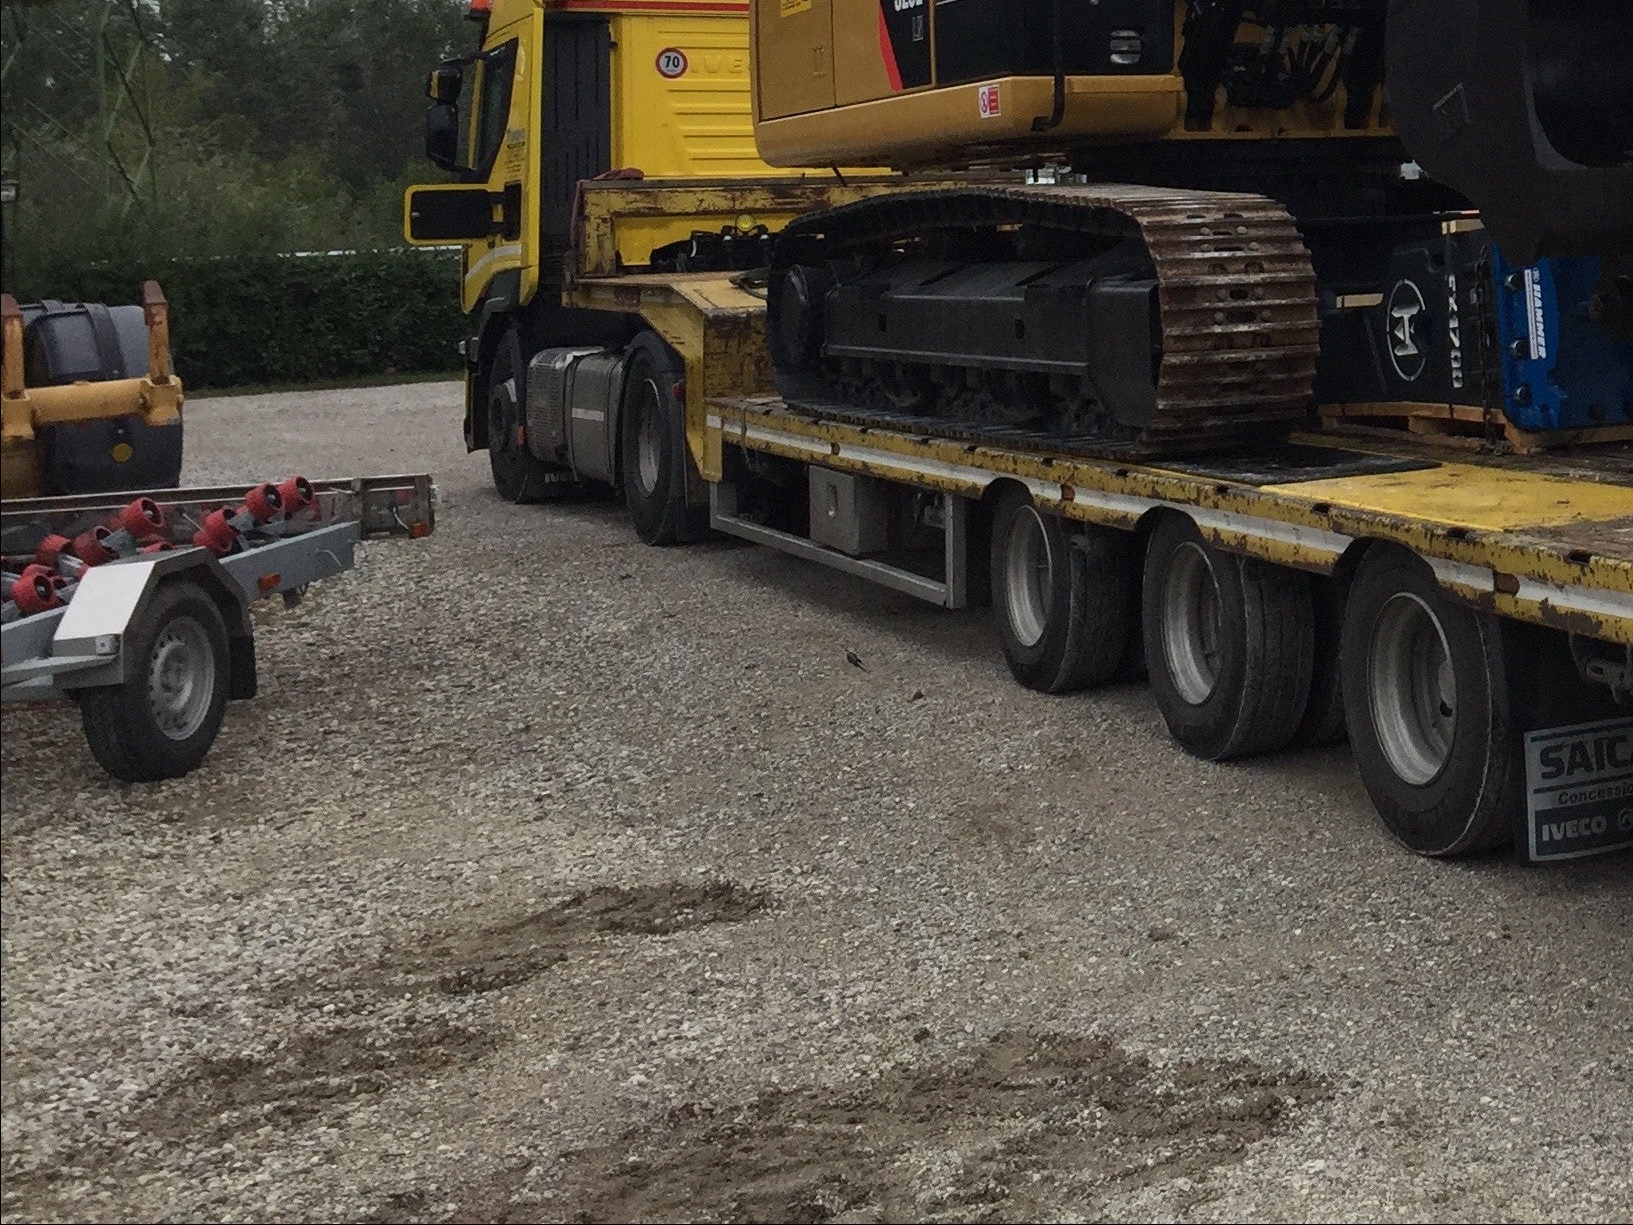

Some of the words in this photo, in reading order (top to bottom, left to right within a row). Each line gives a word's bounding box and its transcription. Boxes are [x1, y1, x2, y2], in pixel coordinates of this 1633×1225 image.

[664, 55, 680, 68] 70
[1532, 284, 1547, 359] HAMMER
[1542, 815, 1607, 842] IVECO
